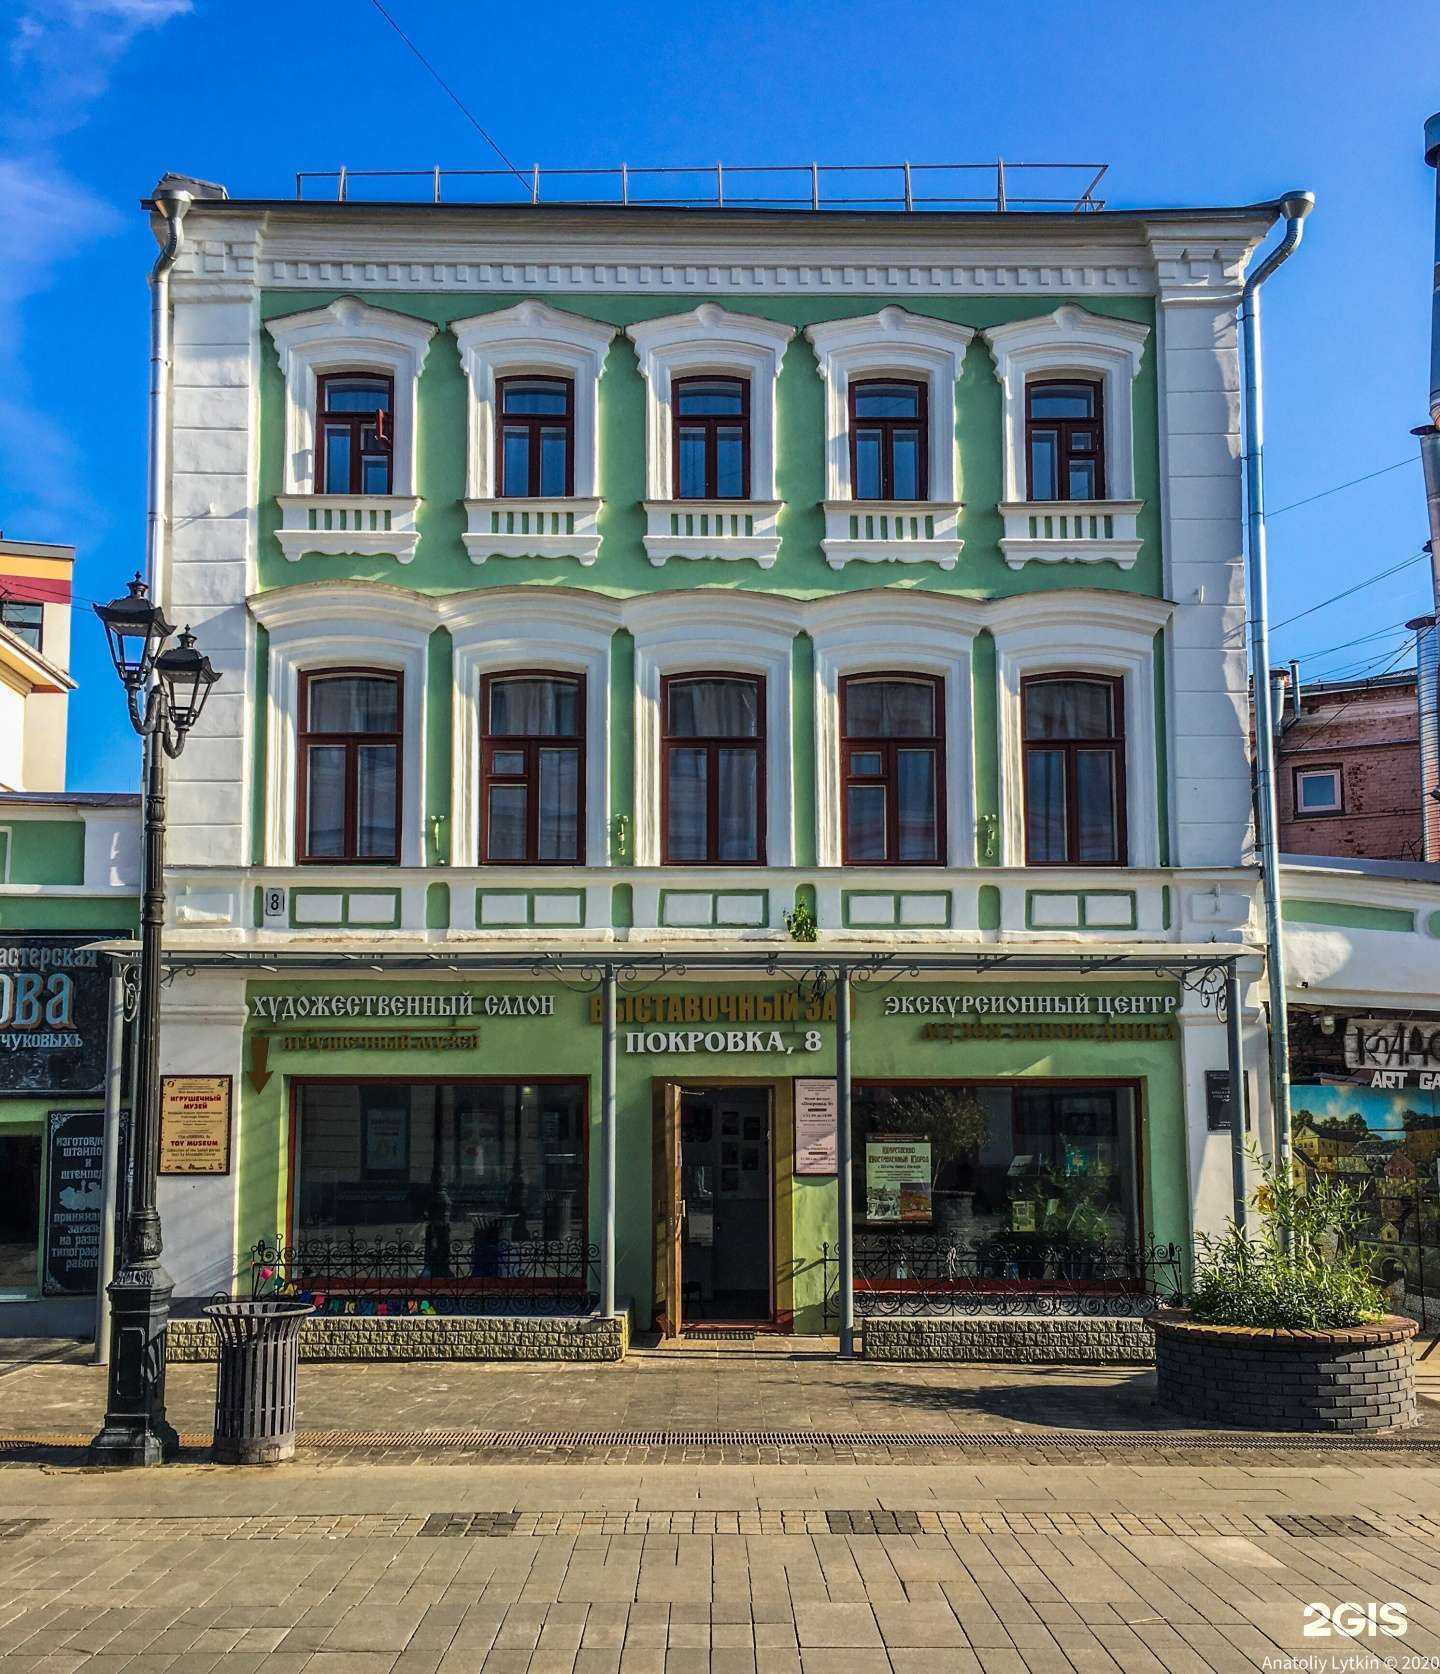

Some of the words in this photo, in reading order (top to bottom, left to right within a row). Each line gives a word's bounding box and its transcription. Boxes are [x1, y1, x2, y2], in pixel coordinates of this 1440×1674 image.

[271, 893, 279, 910] 8
[252, 991, 474, 1022] ХУДОЖЕСТВЕННЫЙ
[484, 994, 556, 1016] САЛОН
[805, 992, 857, 1023] ЗА
[885, 993, 1091, 1018] ЭКСКУРСИОННЫЙ
[1096, 996, 1178, 1018] ЦЕНТР
[625, 1031, 793, 1055] ПОКРОВКА,
[805, 1030, 823, 1052] 8
[1371, 1071, 1408, 1089] ART
